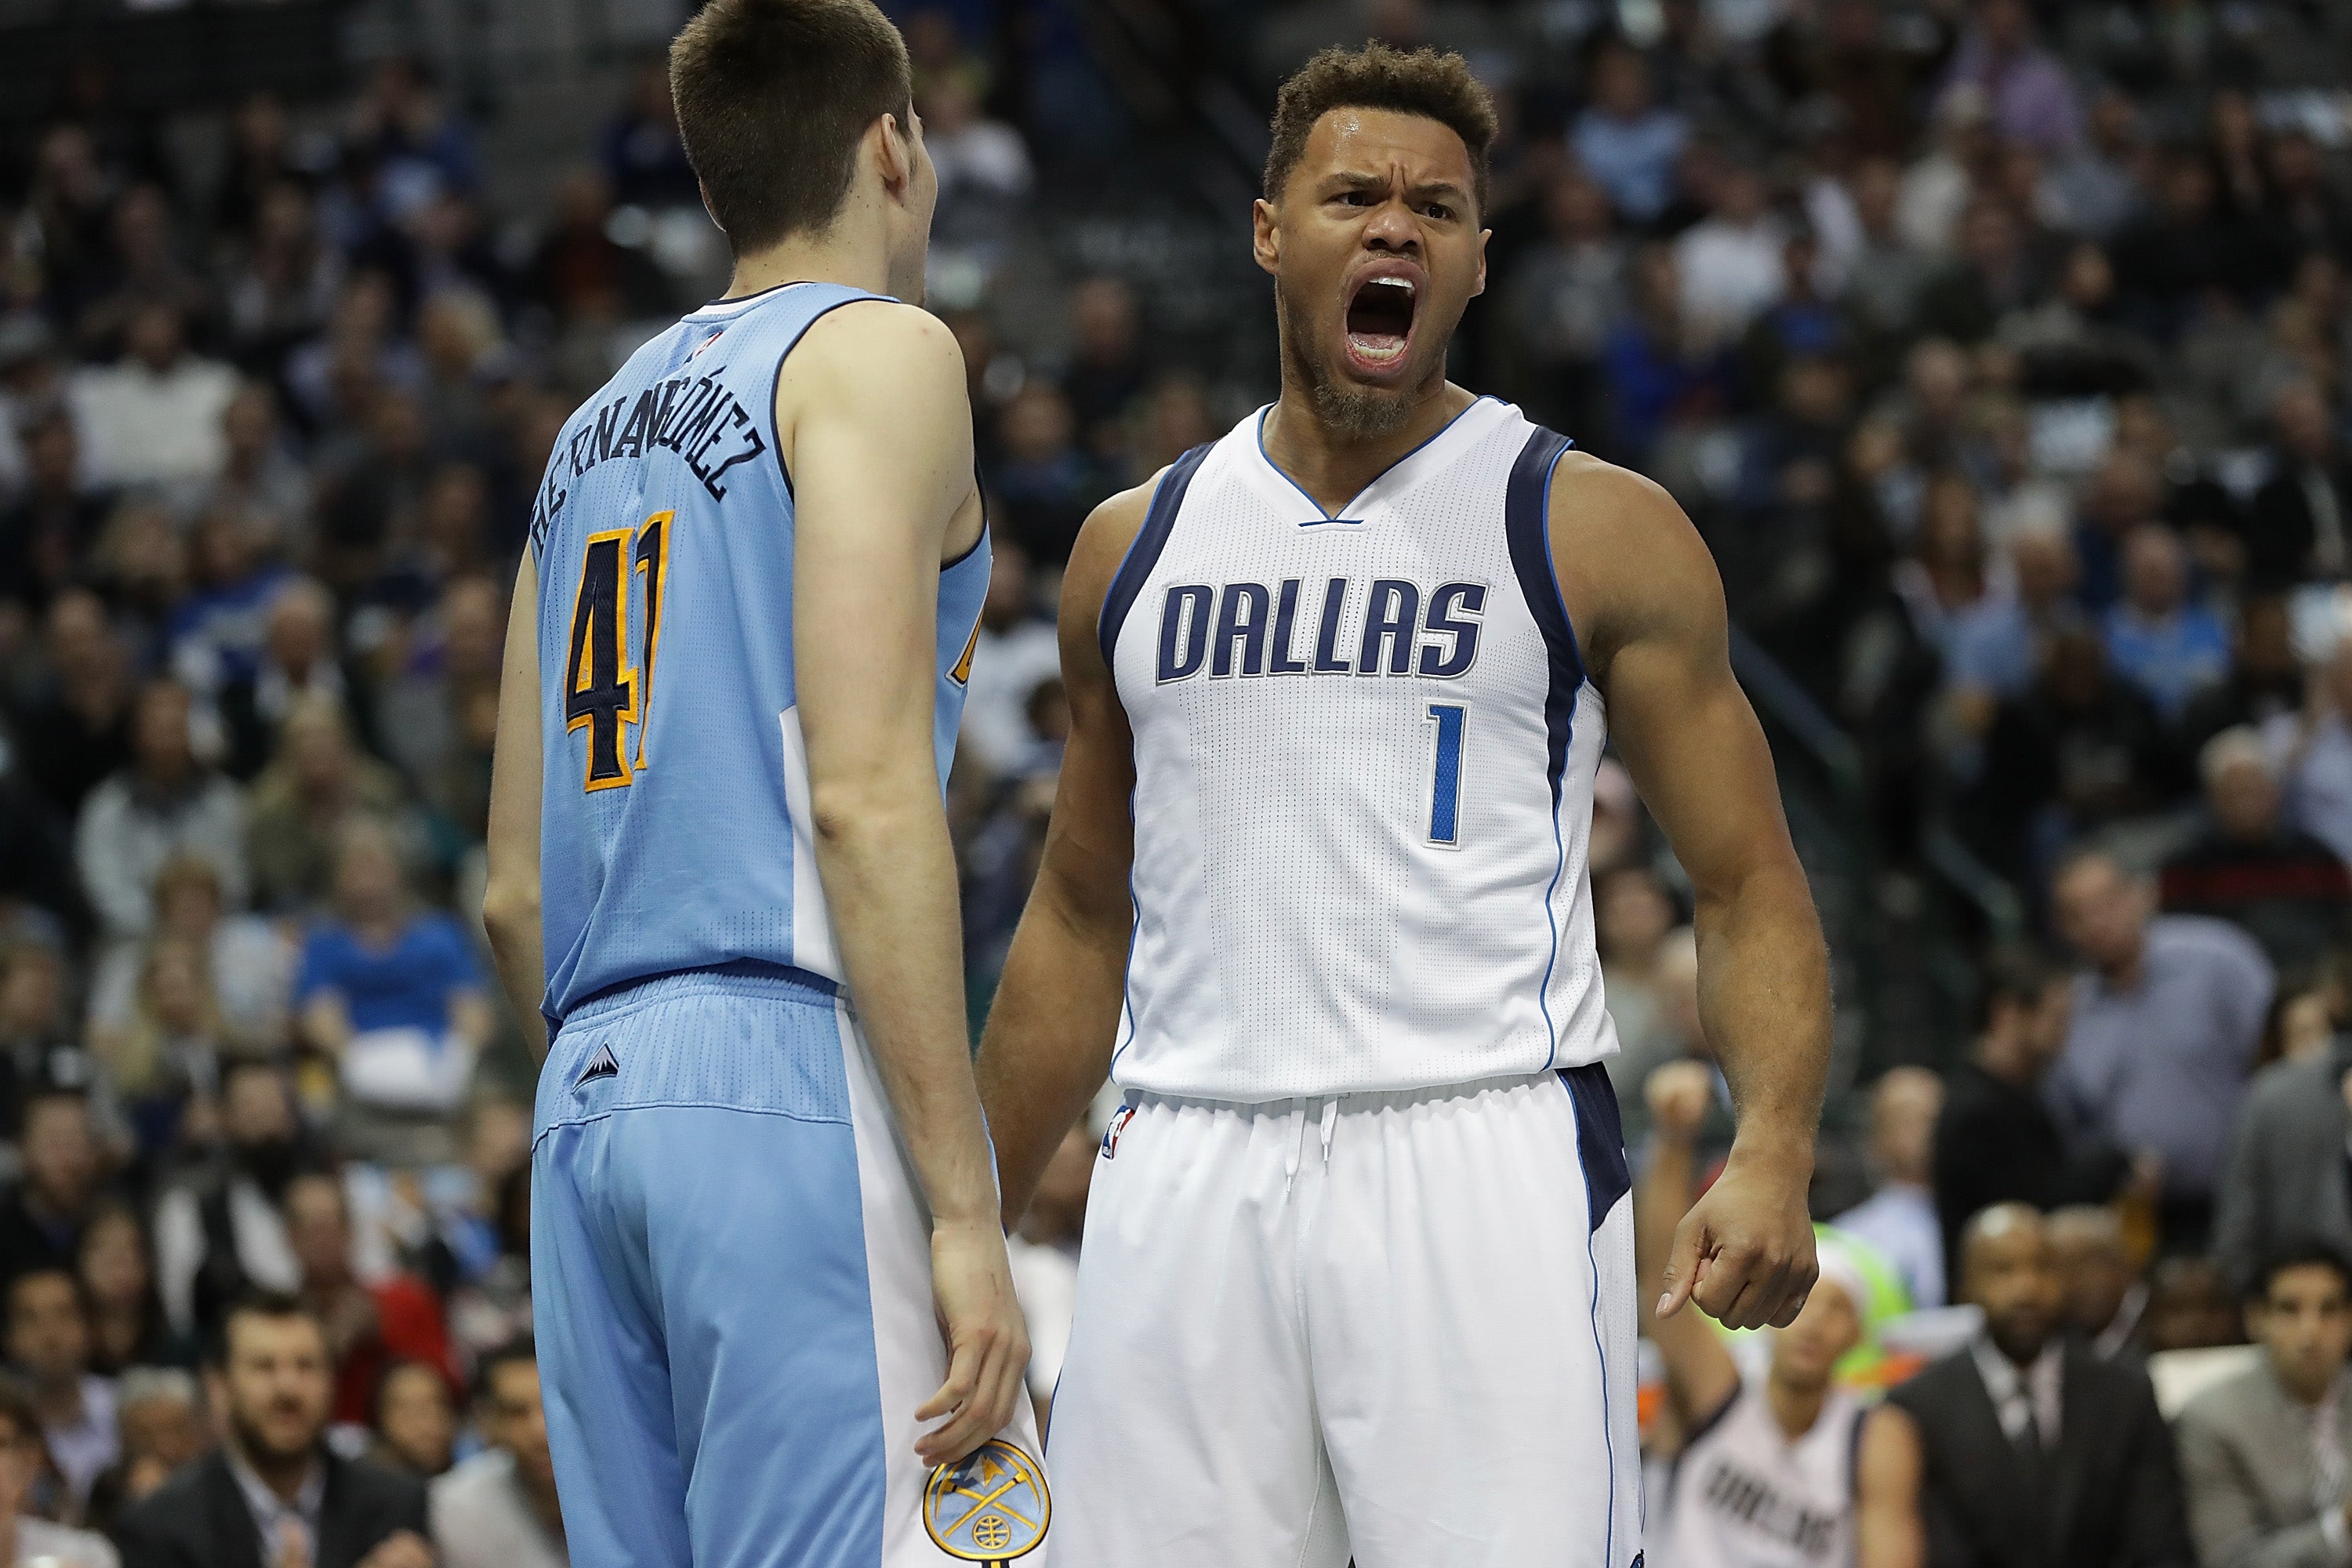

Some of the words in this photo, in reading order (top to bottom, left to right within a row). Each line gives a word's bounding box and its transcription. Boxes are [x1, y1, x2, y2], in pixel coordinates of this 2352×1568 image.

[564, 510, 675, 792] 41
[1156, 575, 1490, 686] DALLAS
[1424, 700, 1469, 848] 1
